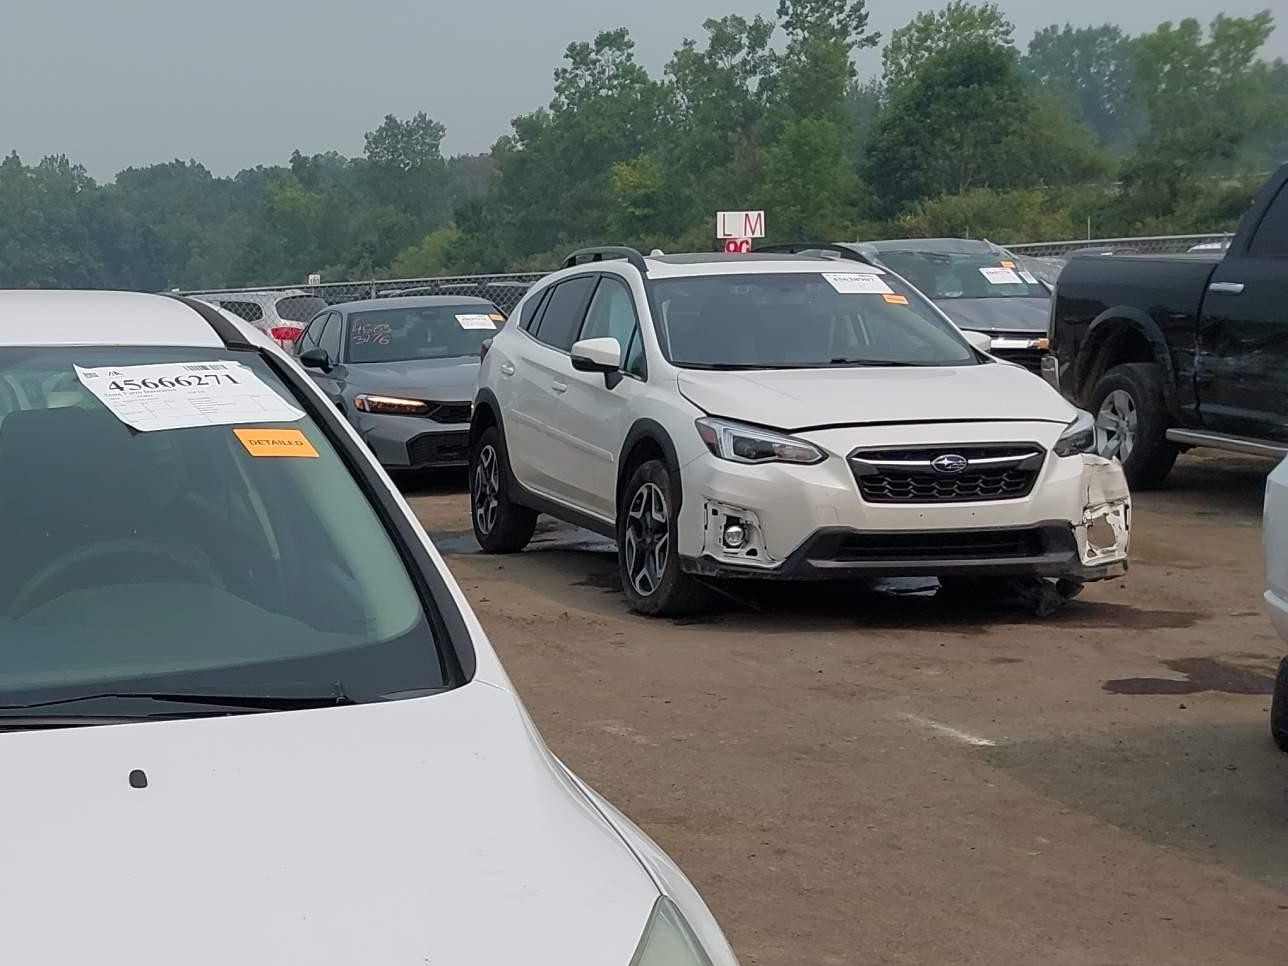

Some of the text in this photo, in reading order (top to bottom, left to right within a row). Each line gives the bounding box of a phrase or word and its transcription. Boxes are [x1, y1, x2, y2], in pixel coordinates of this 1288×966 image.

[722, 212, 763, 236] L M
[108, 373, 243, 392] 45666271
[247, 438, 304, 447] DETAILED
